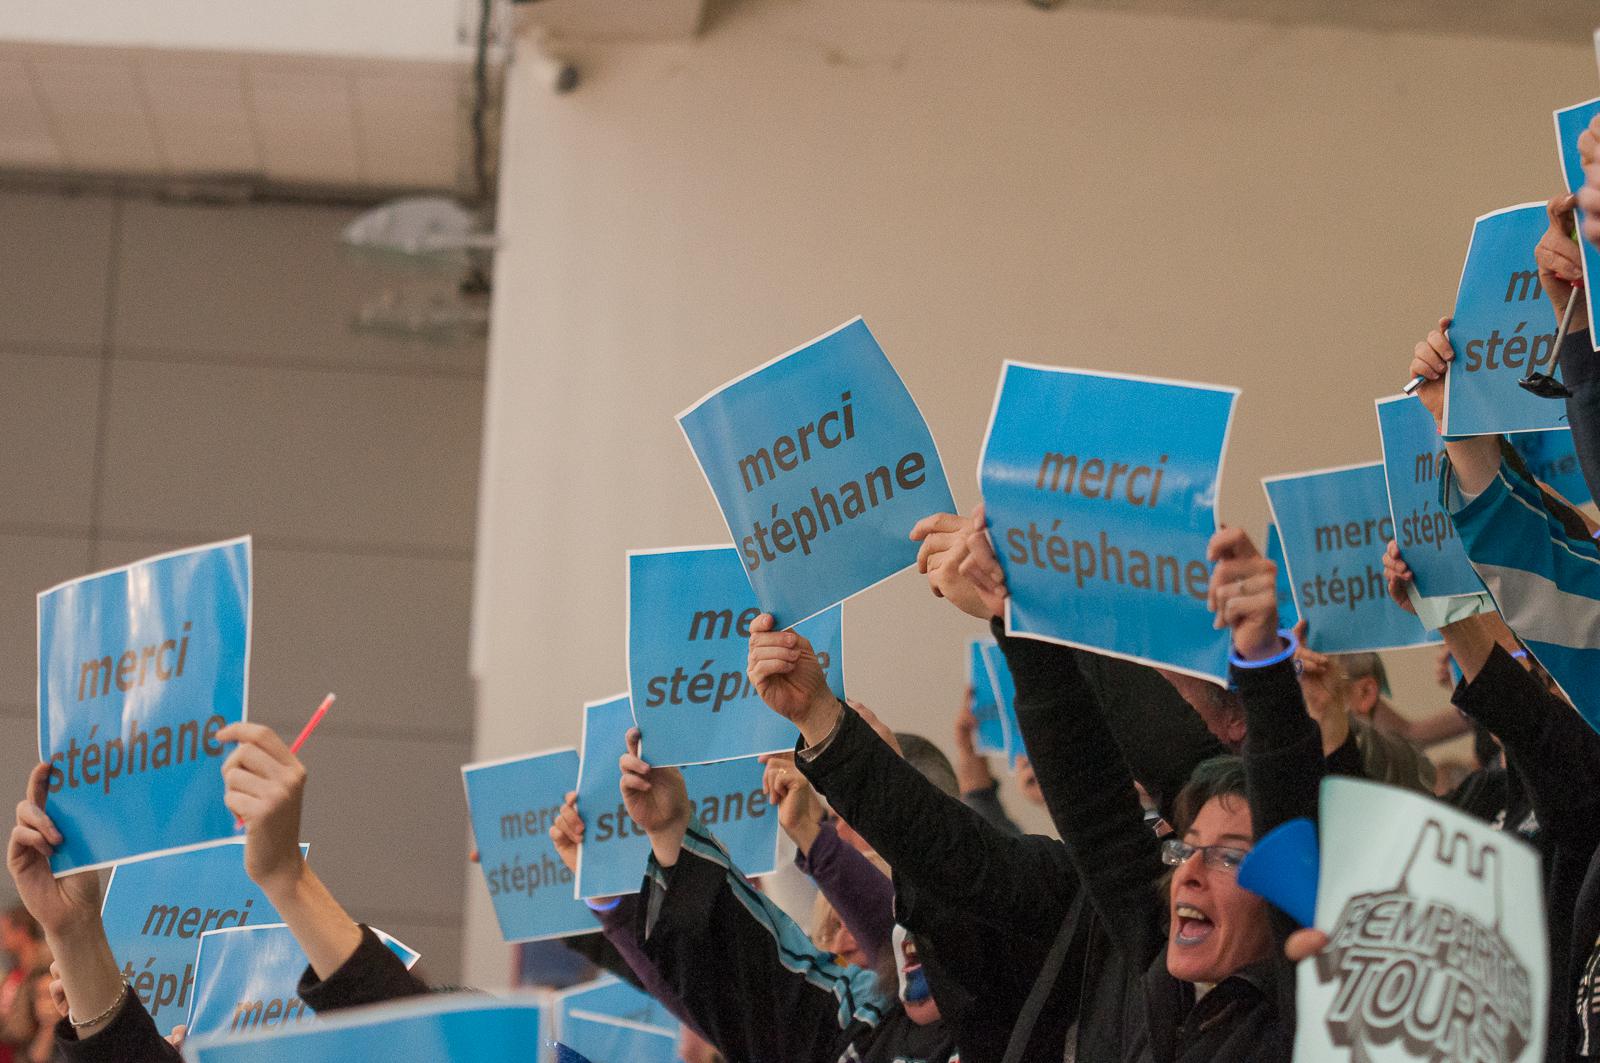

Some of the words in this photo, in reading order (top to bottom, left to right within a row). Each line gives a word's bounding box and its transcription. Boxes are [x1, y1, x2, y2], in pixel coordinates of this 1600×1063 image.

[737, 391, 855, 494] merci
[1036, 451, 1168, 507] merci
[742, 452, 926, 571] stéphane
[1316, 517, 1393, 552] merc
[1007, 520, 1208, 600] stéphane
[1302, 566, 1388, 610] stéph
[78, 621, 192, 700] merci
[49, 715, 227, 794] stéphane
[141, 899, 254, 939] merci
